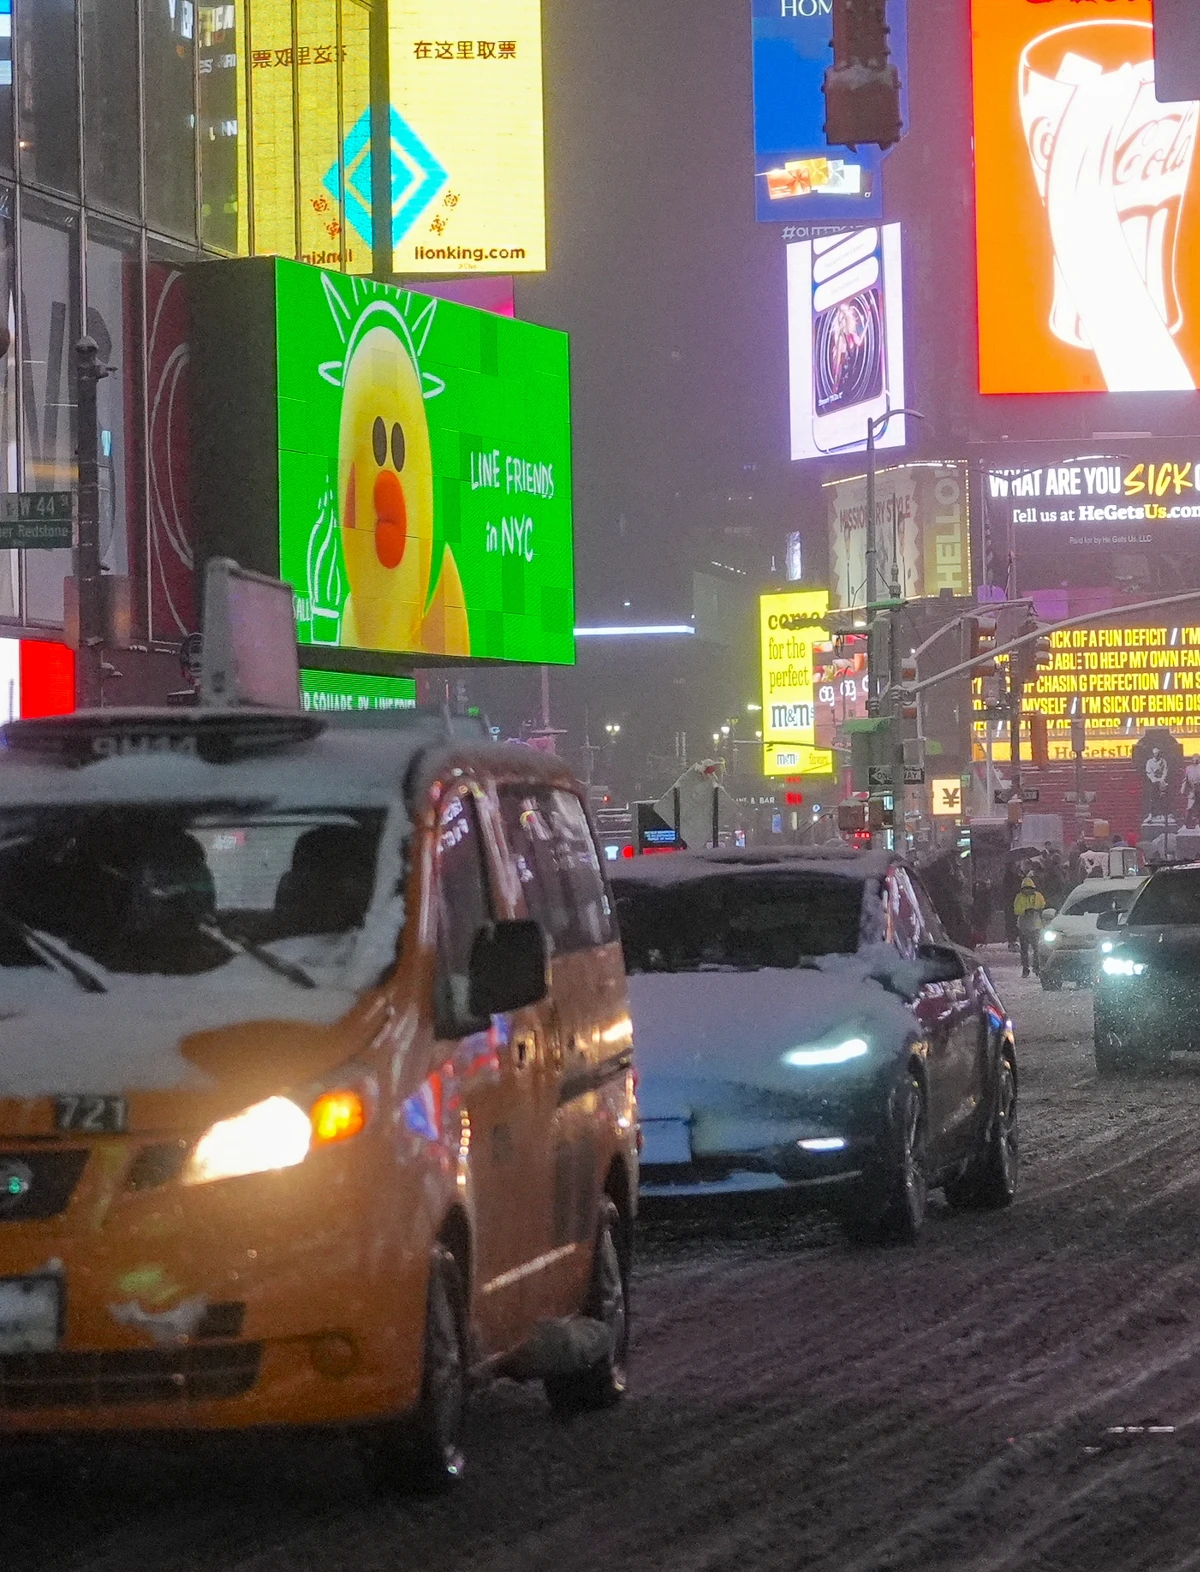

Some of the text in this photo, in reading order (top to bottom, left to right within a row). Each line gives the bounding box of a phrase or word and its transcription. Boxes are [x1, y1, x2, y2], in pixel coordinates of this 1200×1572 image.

[413, 40, 517, 60] 在这里取票
[414, 246, 526, 261] lionking.com
[470, 449, 554, 500] LINE FRIENDS
[989, 468, 1042, 497] WHAT
[1046, 467, 1081, 496] ARE
[1086, 466, 1121, 494] YOU
[1123, 462, 1193, 496] SICK
[37, 496, 55, 516] 44
[1013, 505, 1038, 523] Tell
[1040, 507, 1057, 522] us
[1060, 506, 1076, 521] at
[18, 524, 69, 538] Redstone
[486, 513, 534, 562] in NYC
[1139, 534, 1152, 543] LLC
[768, 635, 806, 660] for the
[1046, 630, 1071, 648] ICK
[1073, 630, 1088, 647] OF
[1089, 630, 1097, 647] A
[1099, 629, 1122, 647] FUN
[1125, 628, 1167, 646] DEFICIT
[1182, 627, 1200, 645] I'M
[1055, 651, 1082, 670] ABLE
[1084, 651, 1098, 669] TO
[1100, 650, 1127, 669] HELP
[1129, 650, 1148, 668] MY
[1150, 649, 1179, 667] OWN
[769, 664, 810, 694] perfect
[1036, 674, 1087, 693] CHASING
[1089, 672, 1159, 691] PERFECTION
[1174, 671, 1194, 690] I'M
[1021, 697, 1067, 715] MYSELF
[1081, 696, 1101, 714] I'M
[1103, 695, 1131, 713] SICK
[1132, 695, 1147, 712] OF
[1148, 693, 1184, 712] BEING
